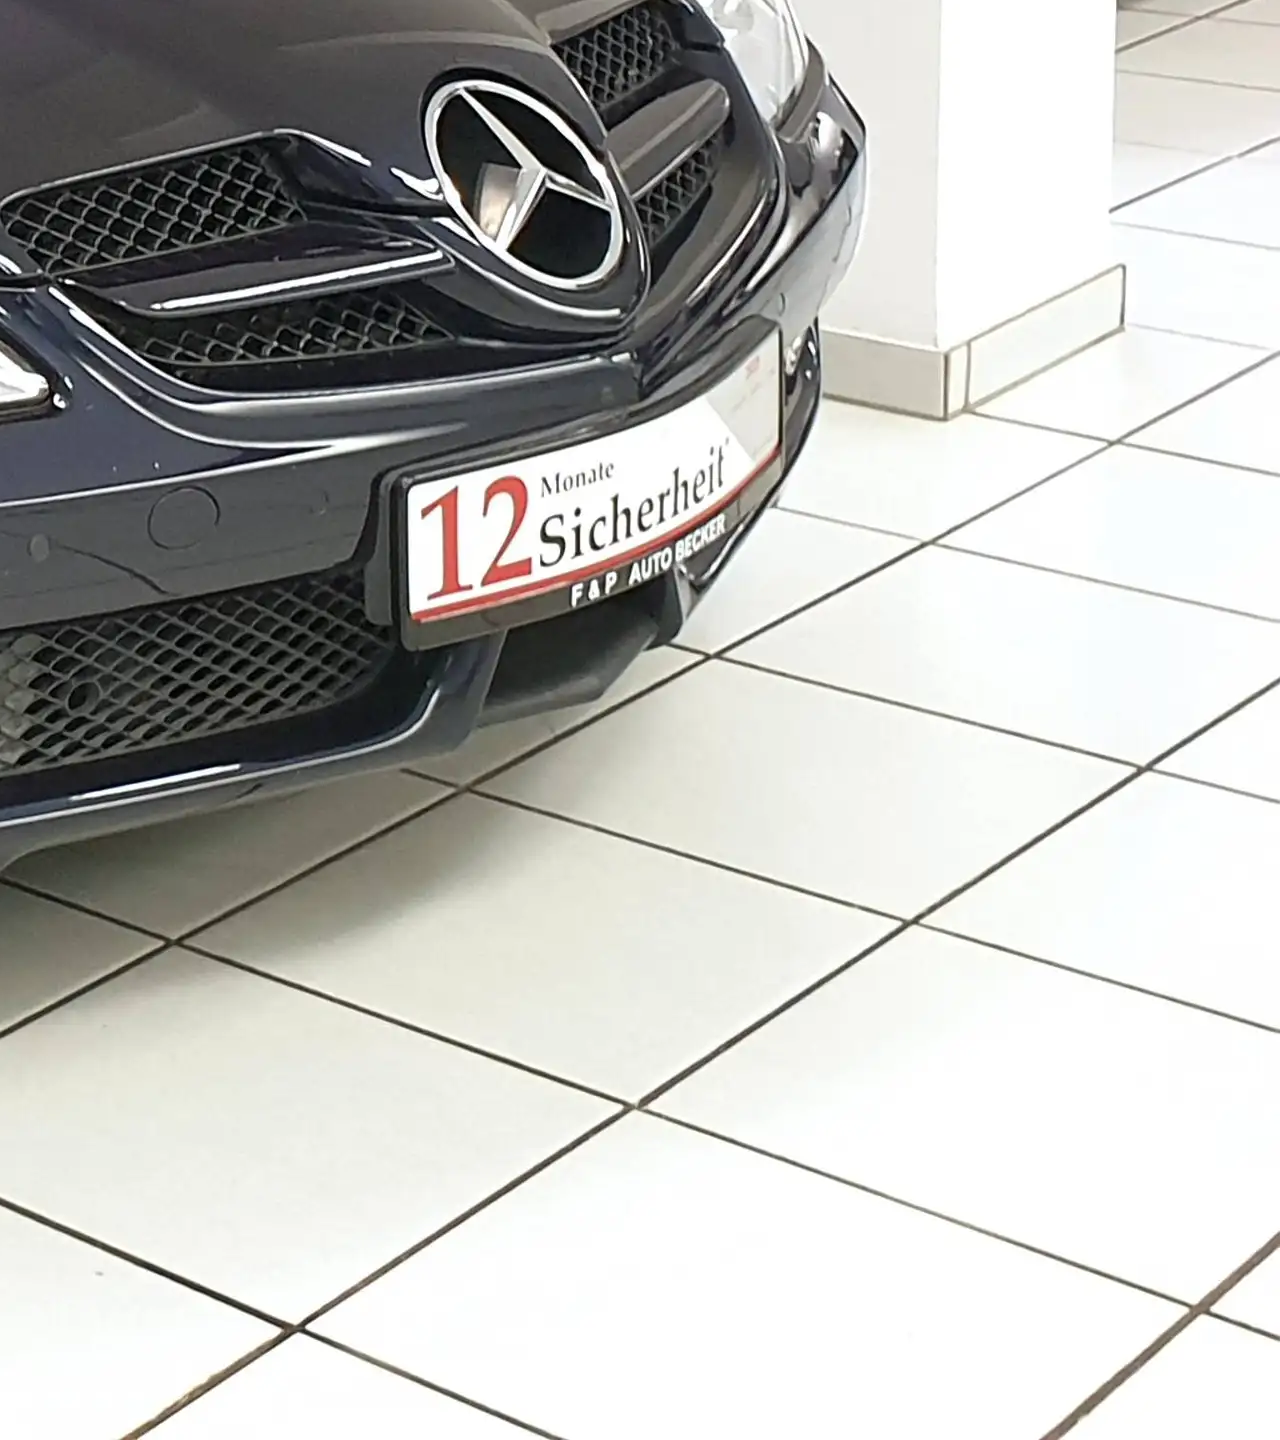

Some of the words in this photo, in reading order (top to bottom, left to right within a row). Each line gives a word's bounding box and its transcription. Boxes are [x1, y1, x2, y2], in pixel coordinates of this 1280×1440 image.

[540, 459, 615, 498] Monate
[420, 475, 533, 601] 12
[538, 445, 724, 568] Sicherheit
[628, 547, 673, 587] AUTO
[675, 513, 727, 563] BECKER
